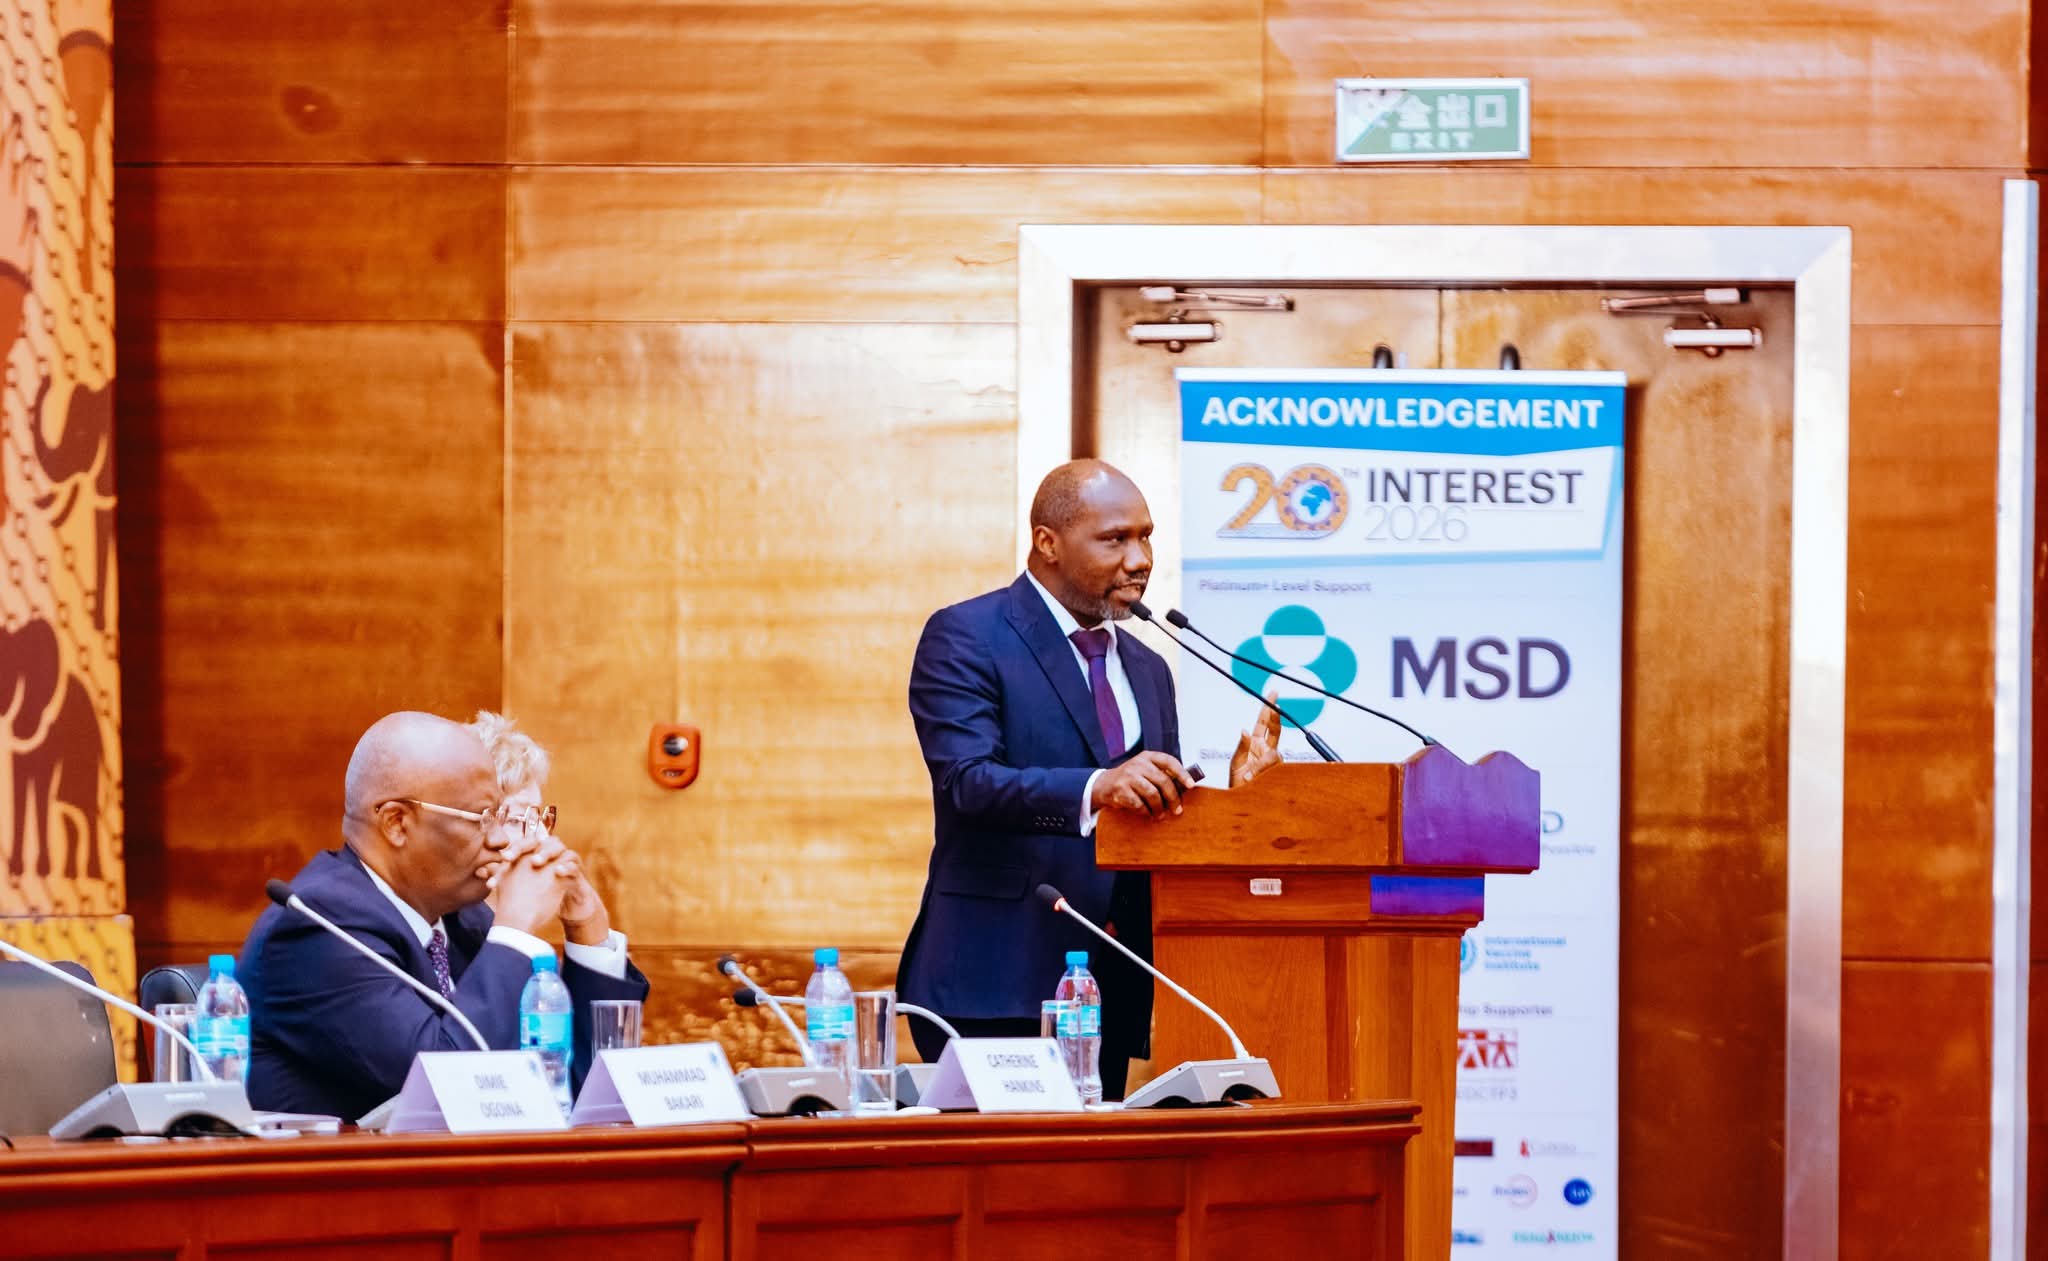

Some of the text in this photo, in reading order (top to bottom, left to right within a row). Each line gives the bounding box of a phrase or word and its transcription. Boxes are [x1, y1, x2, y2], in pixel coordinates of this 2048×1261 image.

[1376, 94, 1507, 130] 全出口
[1391, 131, 1473, 149] EXIT
[1201, 397, 1604, 429] ACKNOWLEDGEMENT
[1367, 468, 1584, 505] INTEREST
[1364, 504, 1469, 542] 2026
[1199, 578, 1371, 596] Platinum+ Level Support
[1391, 635, 1572, 701] MSD
[1200, 748, 1232, 761] Silve
[986, 1053, 1040, 1069] CATHERINE
[636, 1067, 707, 1087] MUHAMMAD
[1001, 1079, 1046, 1094] HANKINS
[663, 1093, 705, 1111] BAKARI
